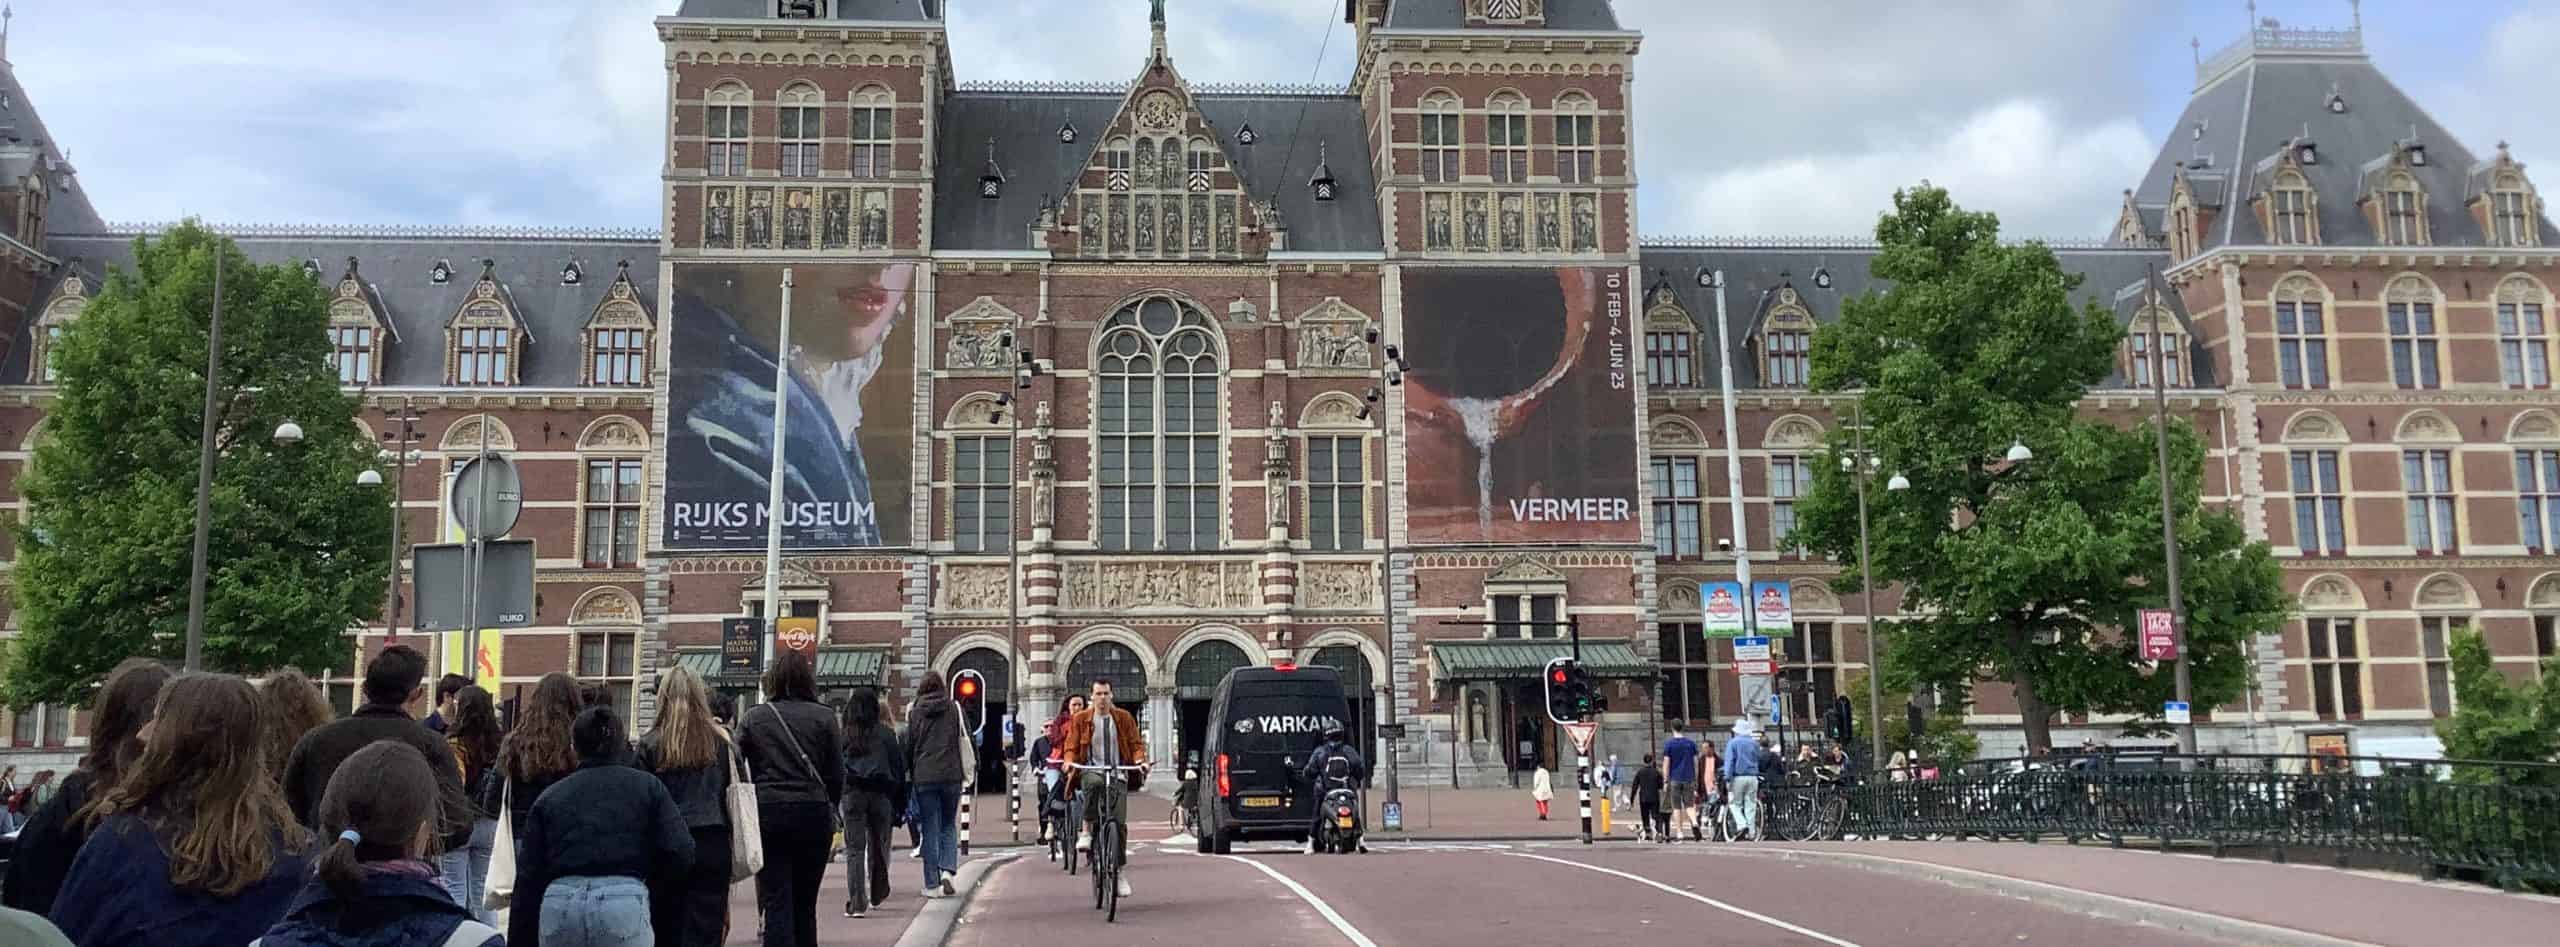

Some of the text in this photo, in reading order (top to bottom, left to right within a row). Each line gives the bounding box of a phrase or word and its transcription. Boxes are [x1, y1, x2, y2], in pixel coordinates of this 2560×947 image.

[1606, 273, 1620, 288] 10
[1609, 340, 1624, 368] JUN
[1611, 372, 1625, 389] 23
[673, 501, 876, 527] RIJKS MUSEUM
[1509, 498, 1630, 521] VERMEER
[499, 614, 524, 622] BUKO
